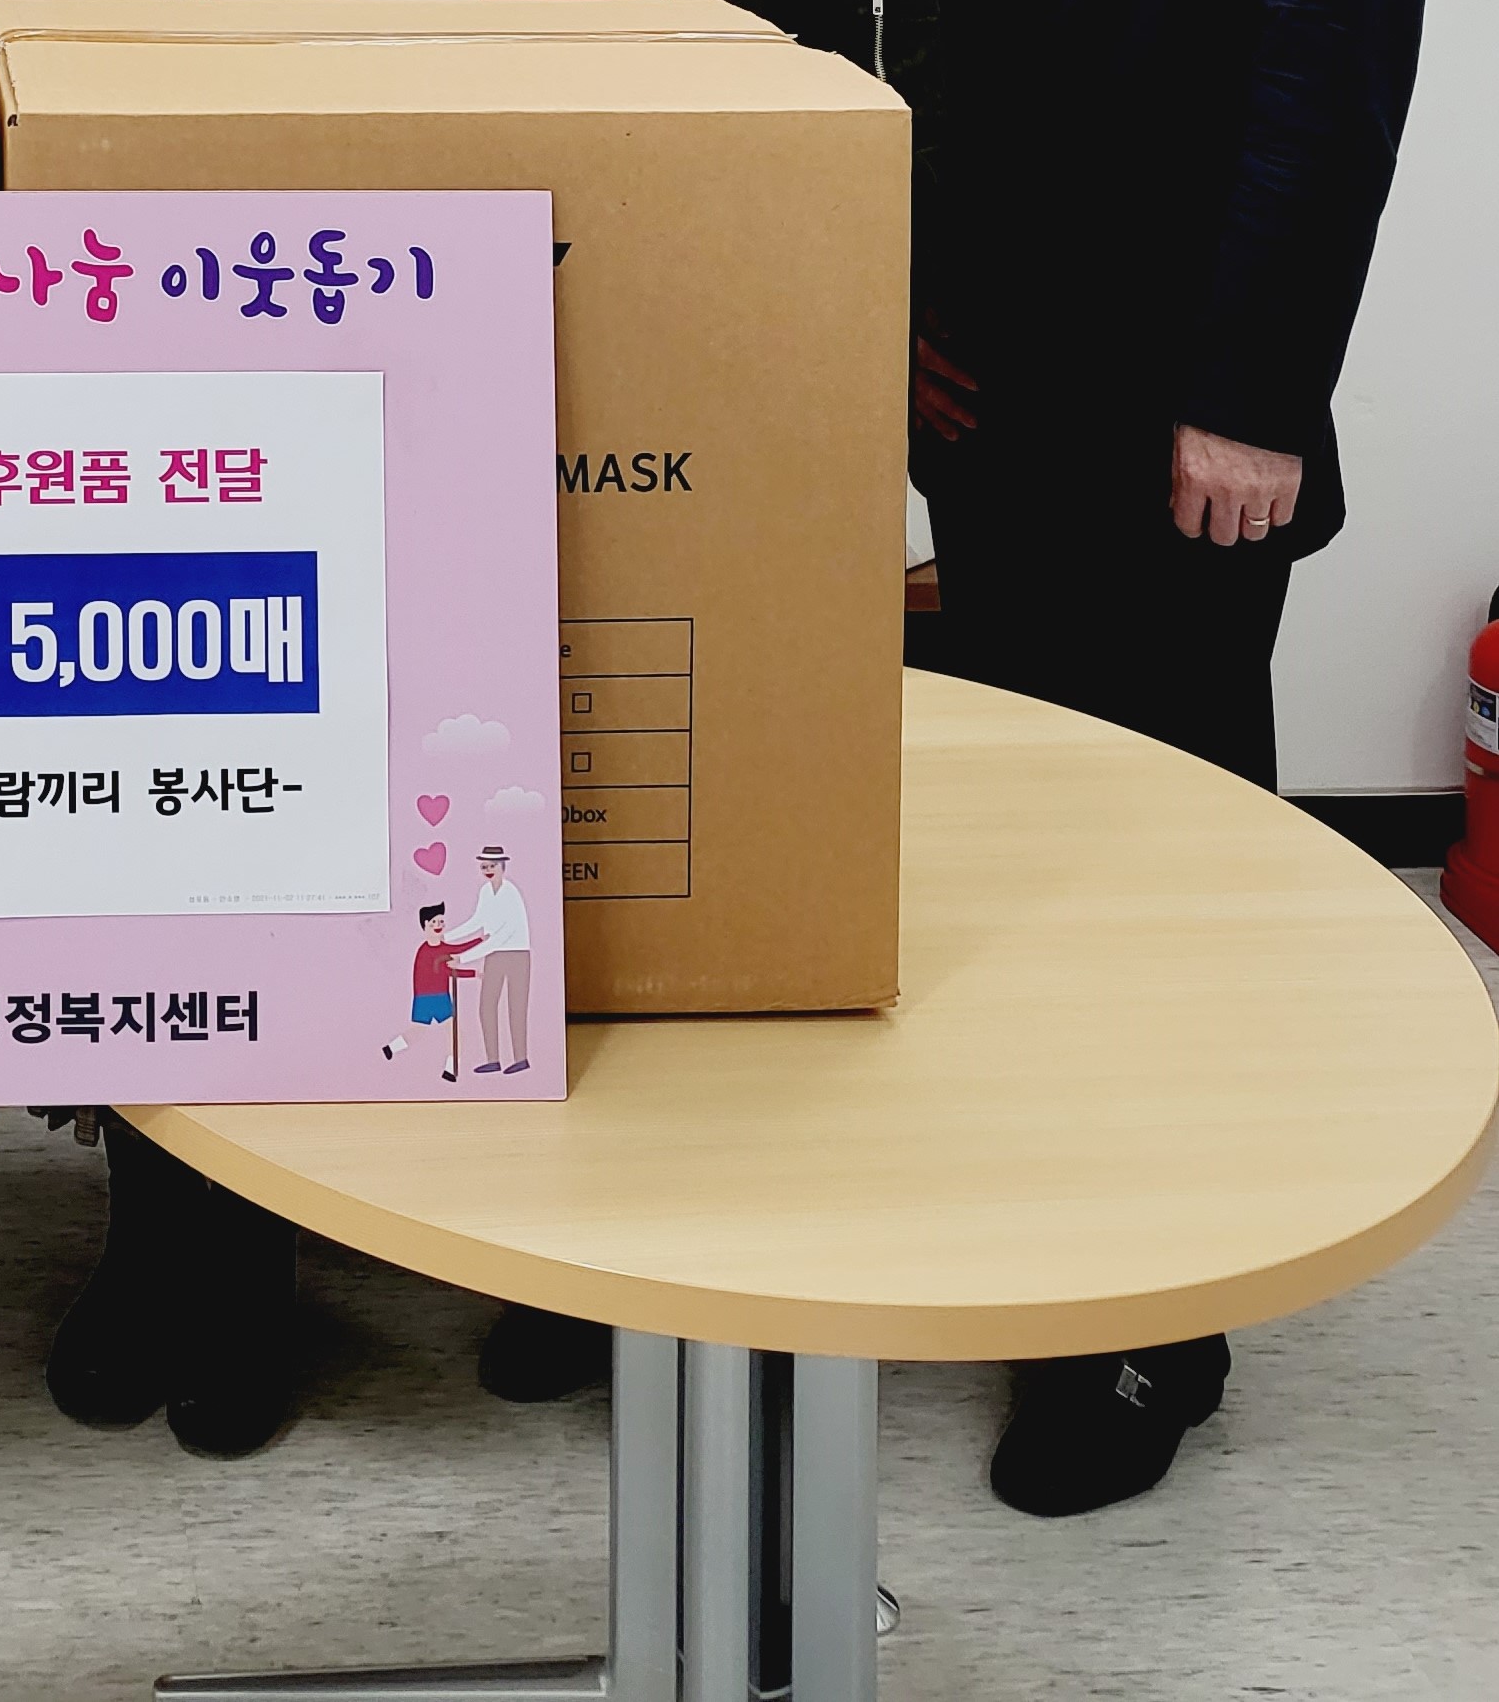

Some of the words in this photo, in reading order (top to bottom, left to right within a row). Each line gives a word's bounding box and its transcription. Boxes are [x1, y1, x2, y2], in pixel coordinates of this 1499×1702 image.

[162, 229, 435, 326] 이웃돕기
[159, 449, 269, 504] 전달
[11, 597, 304, 689] 5,000매
[149, 768, 304, 817] 봉사단-
